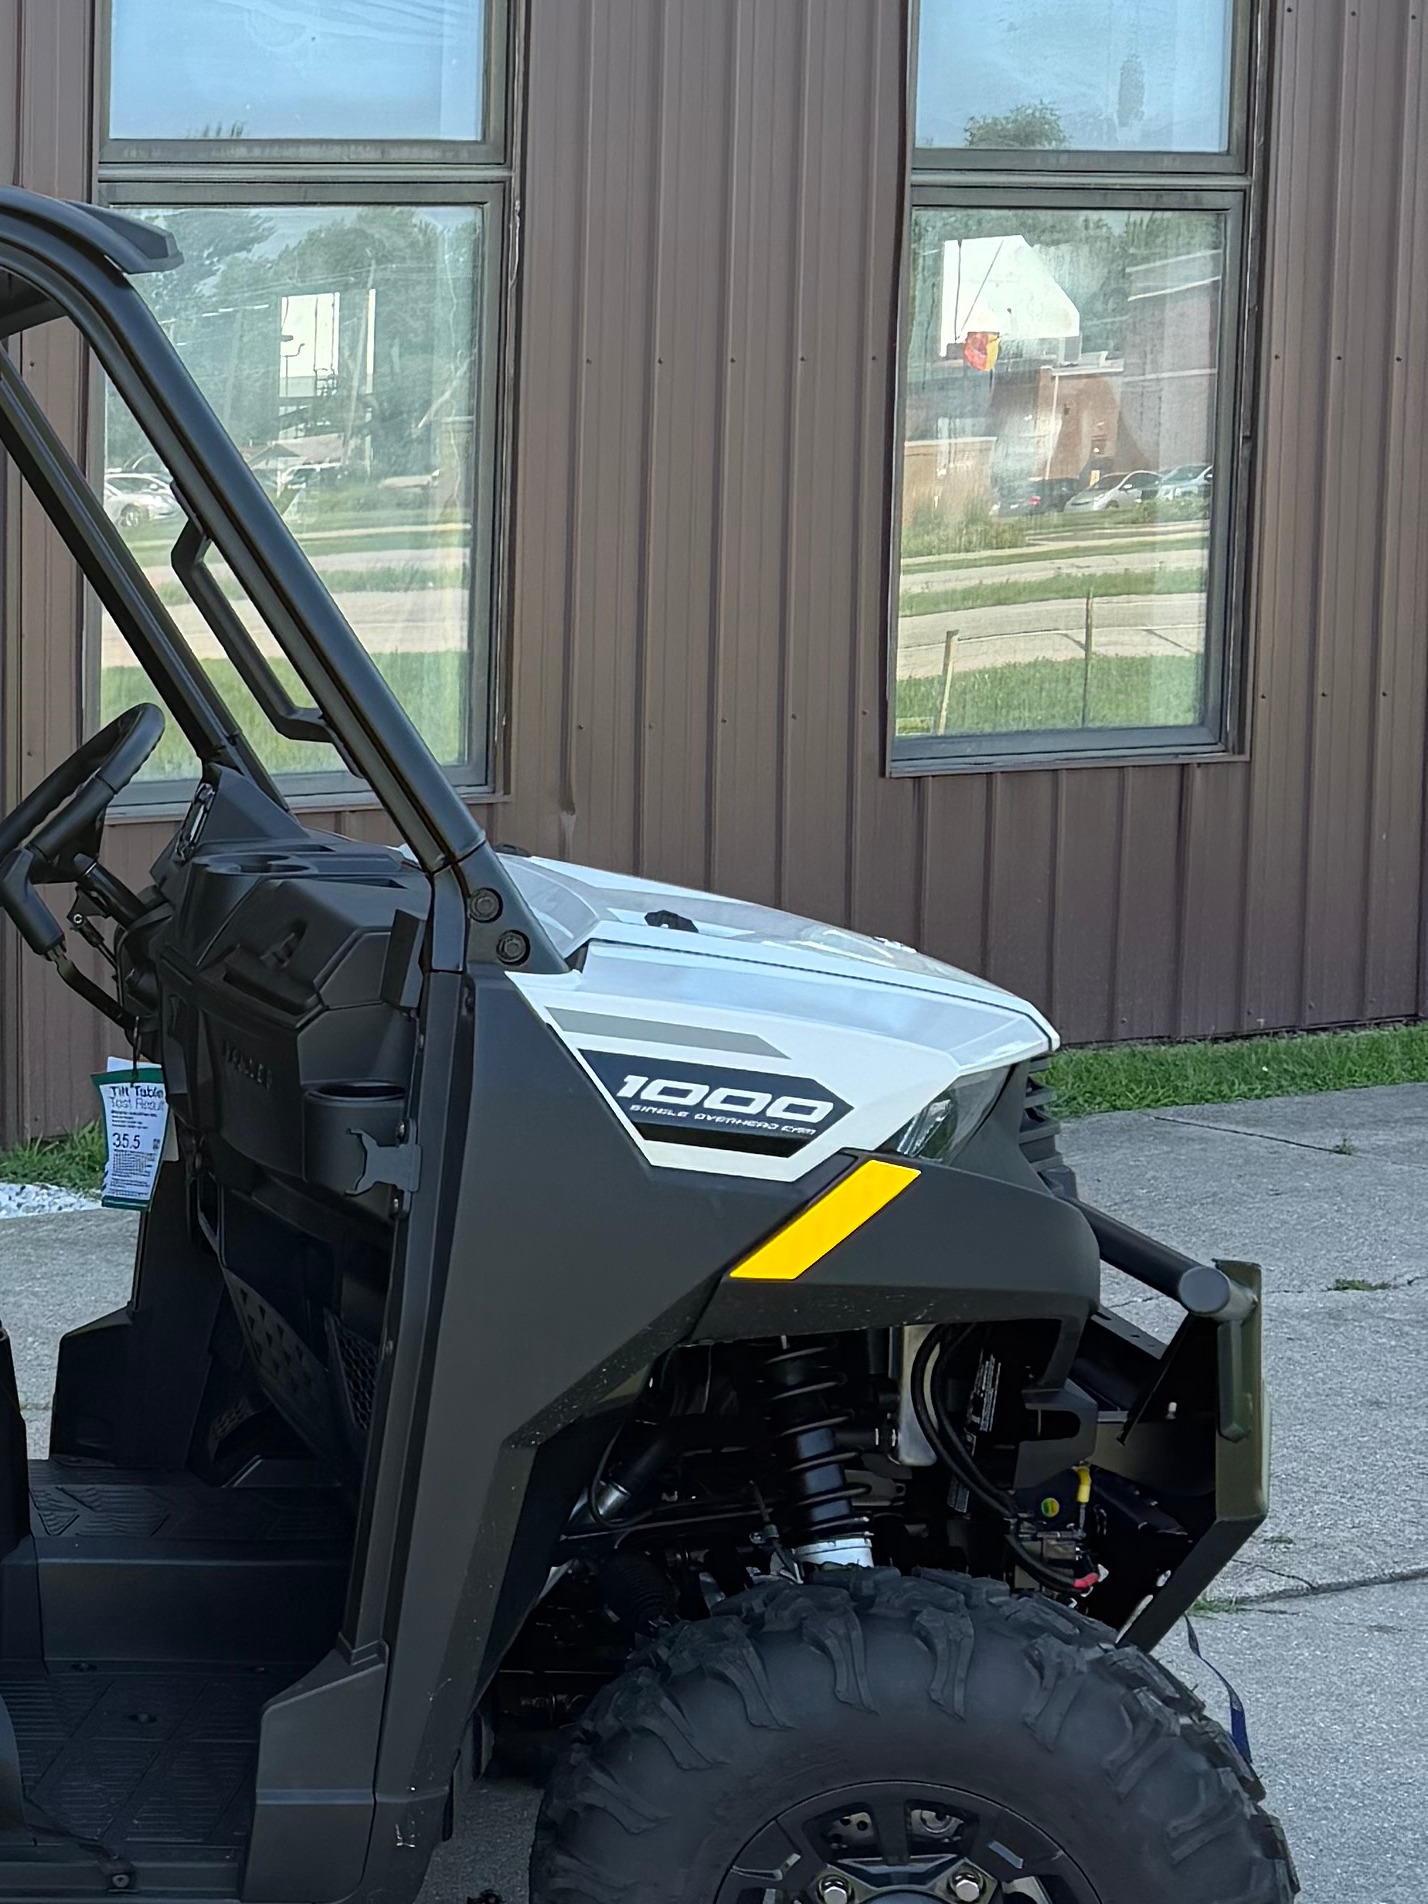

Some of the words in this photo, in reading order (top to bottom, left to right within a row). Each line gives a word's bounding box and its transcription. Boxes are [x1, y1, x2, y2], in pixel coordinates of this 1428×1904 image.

[109, 1085, 129, 1098] Tilt
[615, 1074, 834, 1124] 1000
[629, 1104, 690, 1118] SINGLE
[693, 1112, 780, 1132] OVERHEAD
[780, 1124, 817, 1137] CAM
[111, 1132, 142, 1150] 35.5
